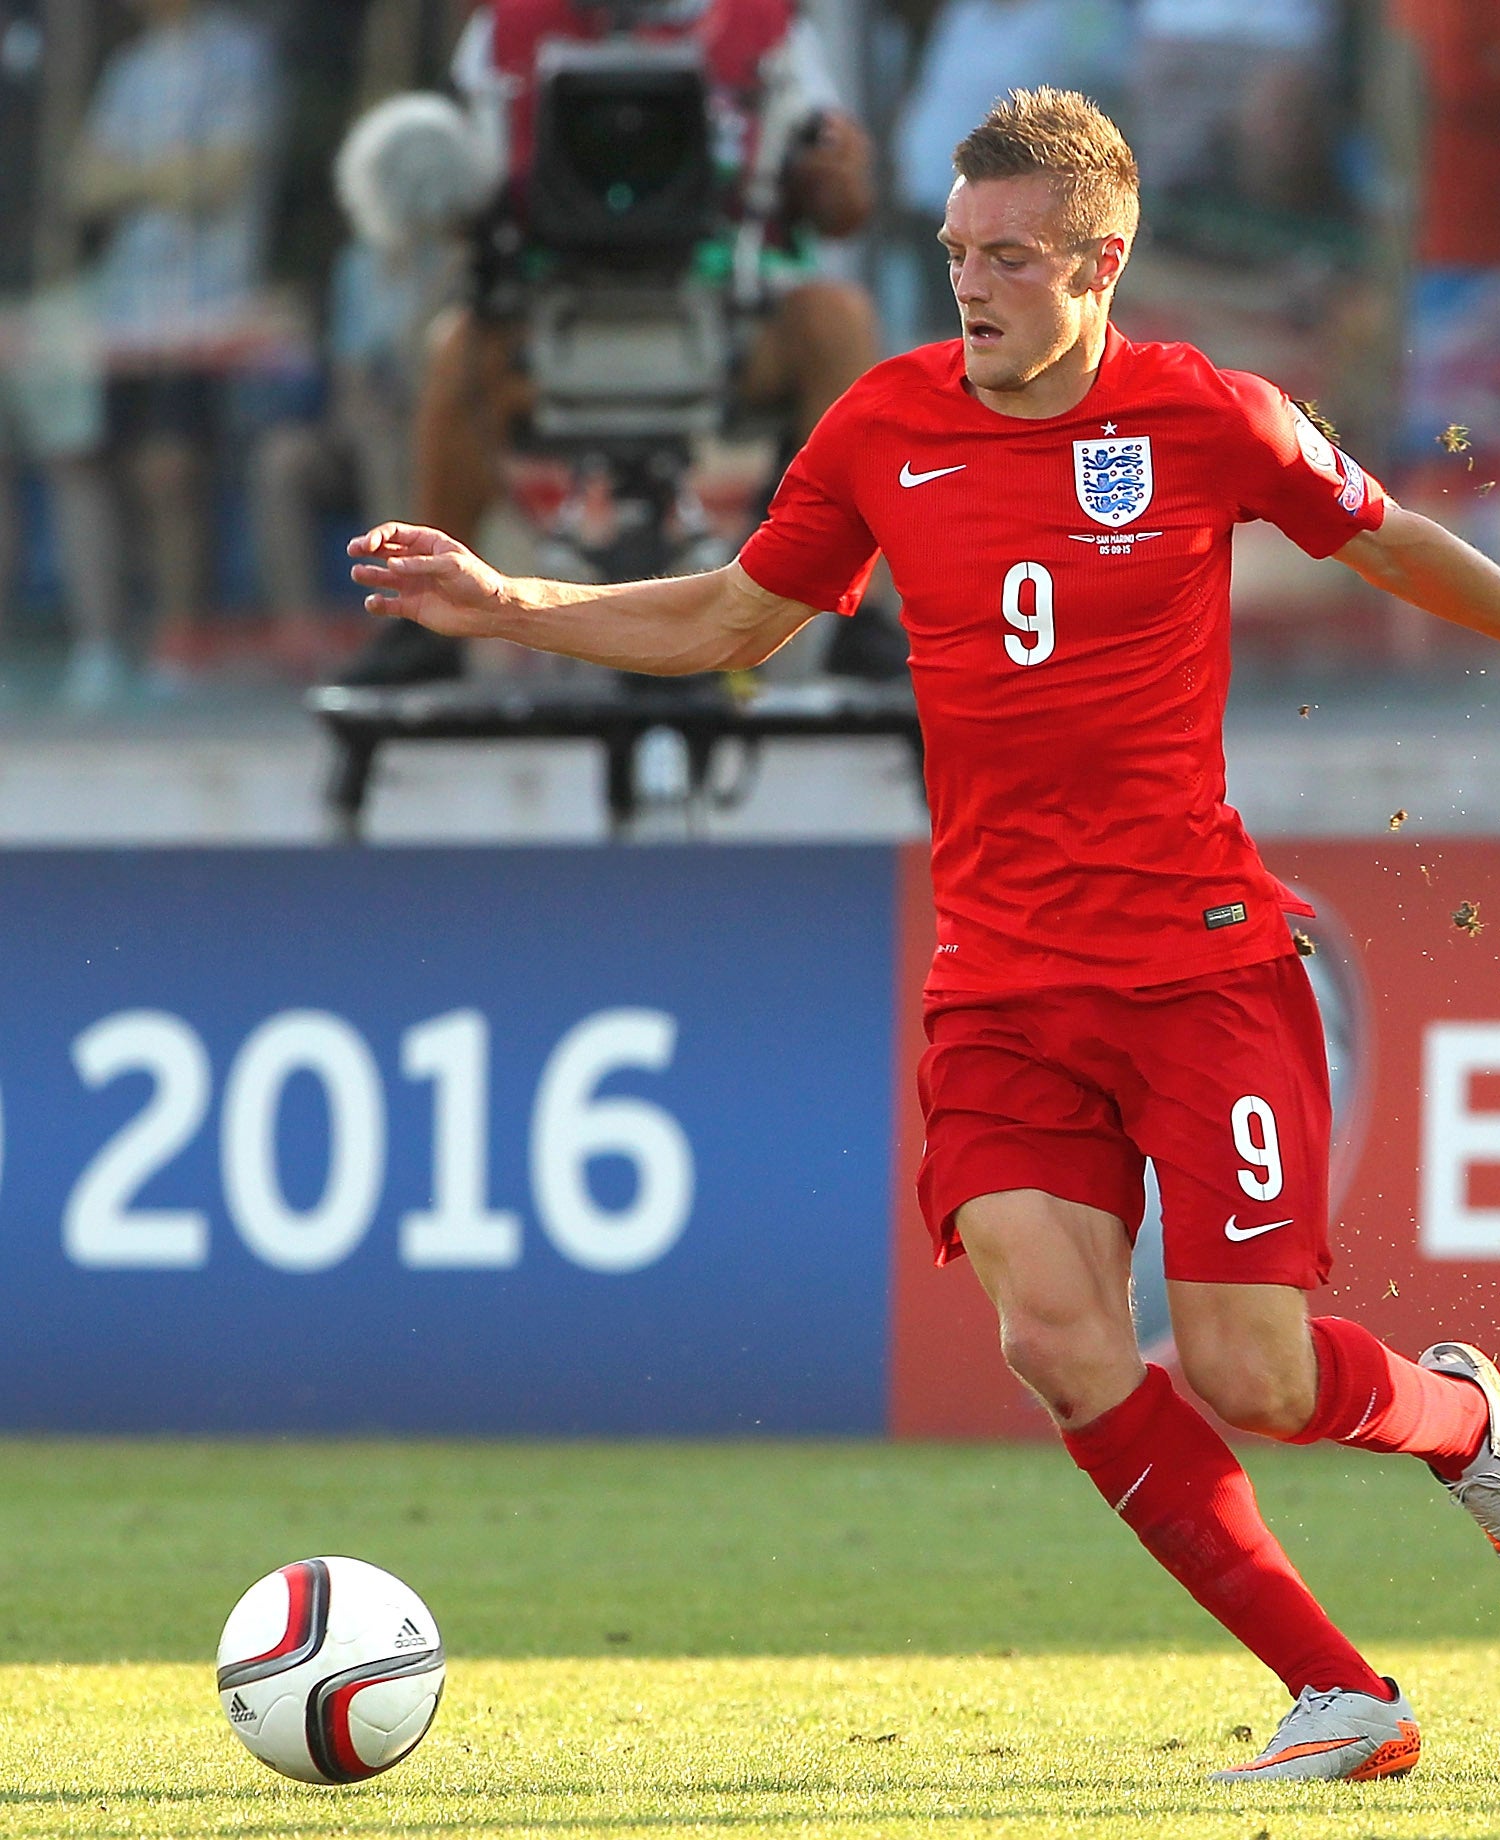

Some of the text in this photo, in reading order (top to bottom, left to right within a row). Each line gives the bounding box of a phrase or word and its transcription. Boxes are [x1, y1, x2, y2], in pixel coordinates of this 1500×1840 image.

[1096, 534, 1135, 544] SAN MARINO
[1002, 561, 1054, 666] 9
[62, 1006, 696, 1274] 2016
[1230, 1095, 1284, 1201] 9
